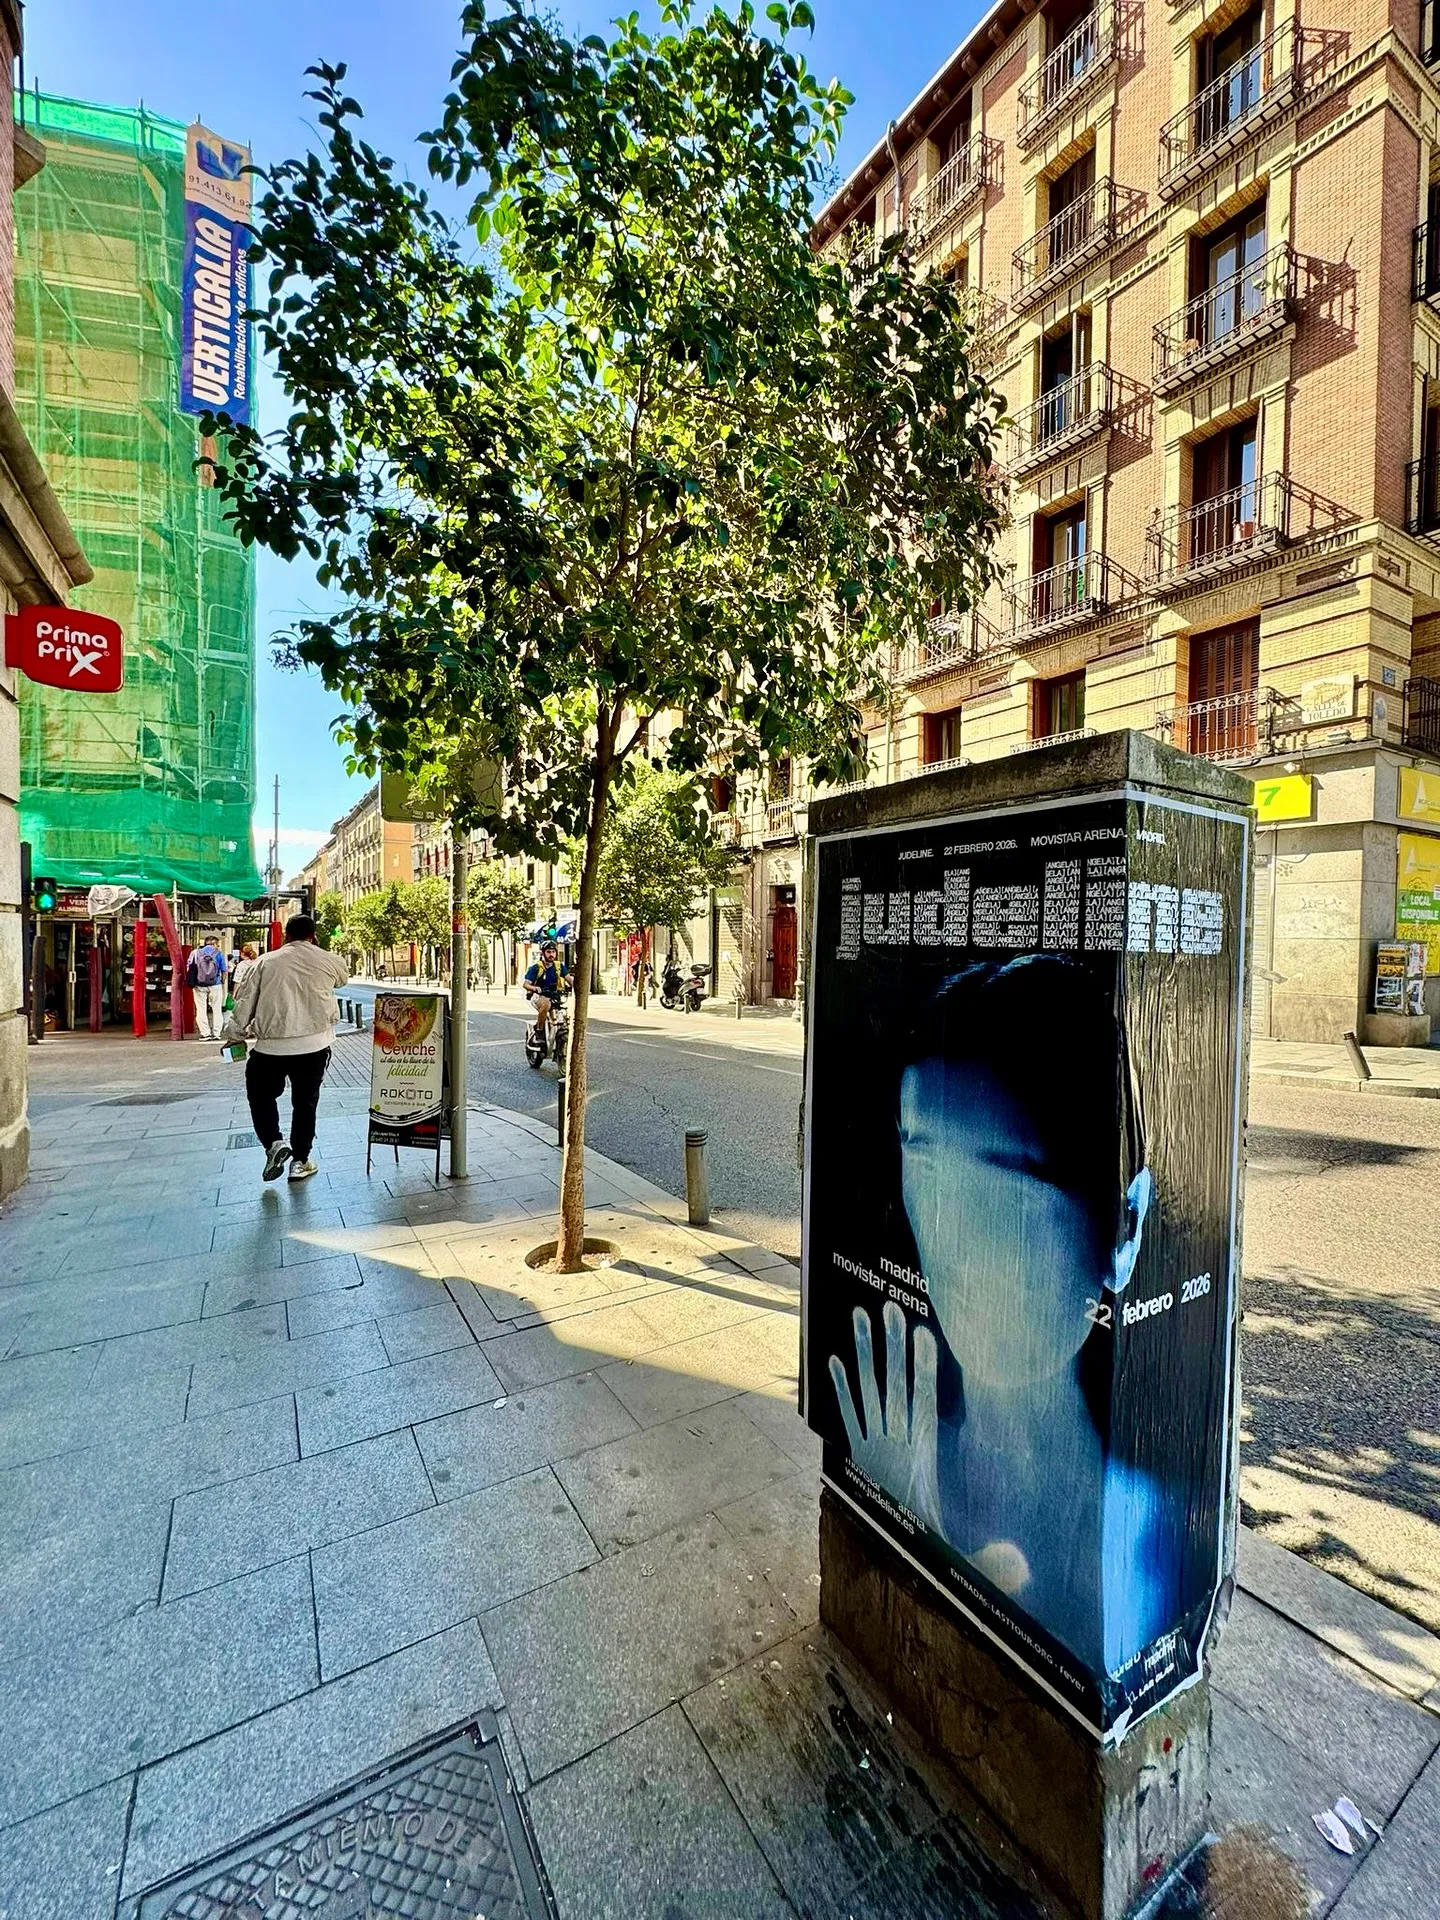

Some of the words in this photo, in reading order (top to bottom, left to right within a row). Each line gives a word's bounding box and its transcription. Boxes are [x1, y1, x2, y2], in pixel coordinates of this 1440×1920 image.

[235, 248, 247, 299] edificios
[193, 217, 232, 406] VERTICALIA
[234, 317, 246, 400] Rehabilitación
[36, 621, 108, 649] Prima
[1308, 707, 1346, 721] TOLEDO
[1258, 786, 1282, 807] 7
[943, 846, 953, 856] 22
[953, 841, 994, 855] FEBRERO
[994, 839, 1019, 851] 2026.
[1030, 831, 1083, 847] MOVISTAR
[1083, 827, 1129, 842] ARENA.
[1410, 894, 1431, 907] LOCAL
[381, 1041, 436, 1056] Ceviche
[386, 1064, 429, 1081] felicidad
[380, 1088, 433, 1100] ROKOTO
[833, 1251, 887, 1291] movistar
[888, 1284, 929, 1317] arena
[880, 1256, 930, 1295] madrid
[1084, 1297, 1112, 1330] 22
[1122, 1292, 1174, 1327] febrero
[1181, 1272, 1211, 1304] 2026
[845, 1466, 915, 1535] www.judeline.es
[991, 1604, 1053, 1665] LASTTOUR.ORG
